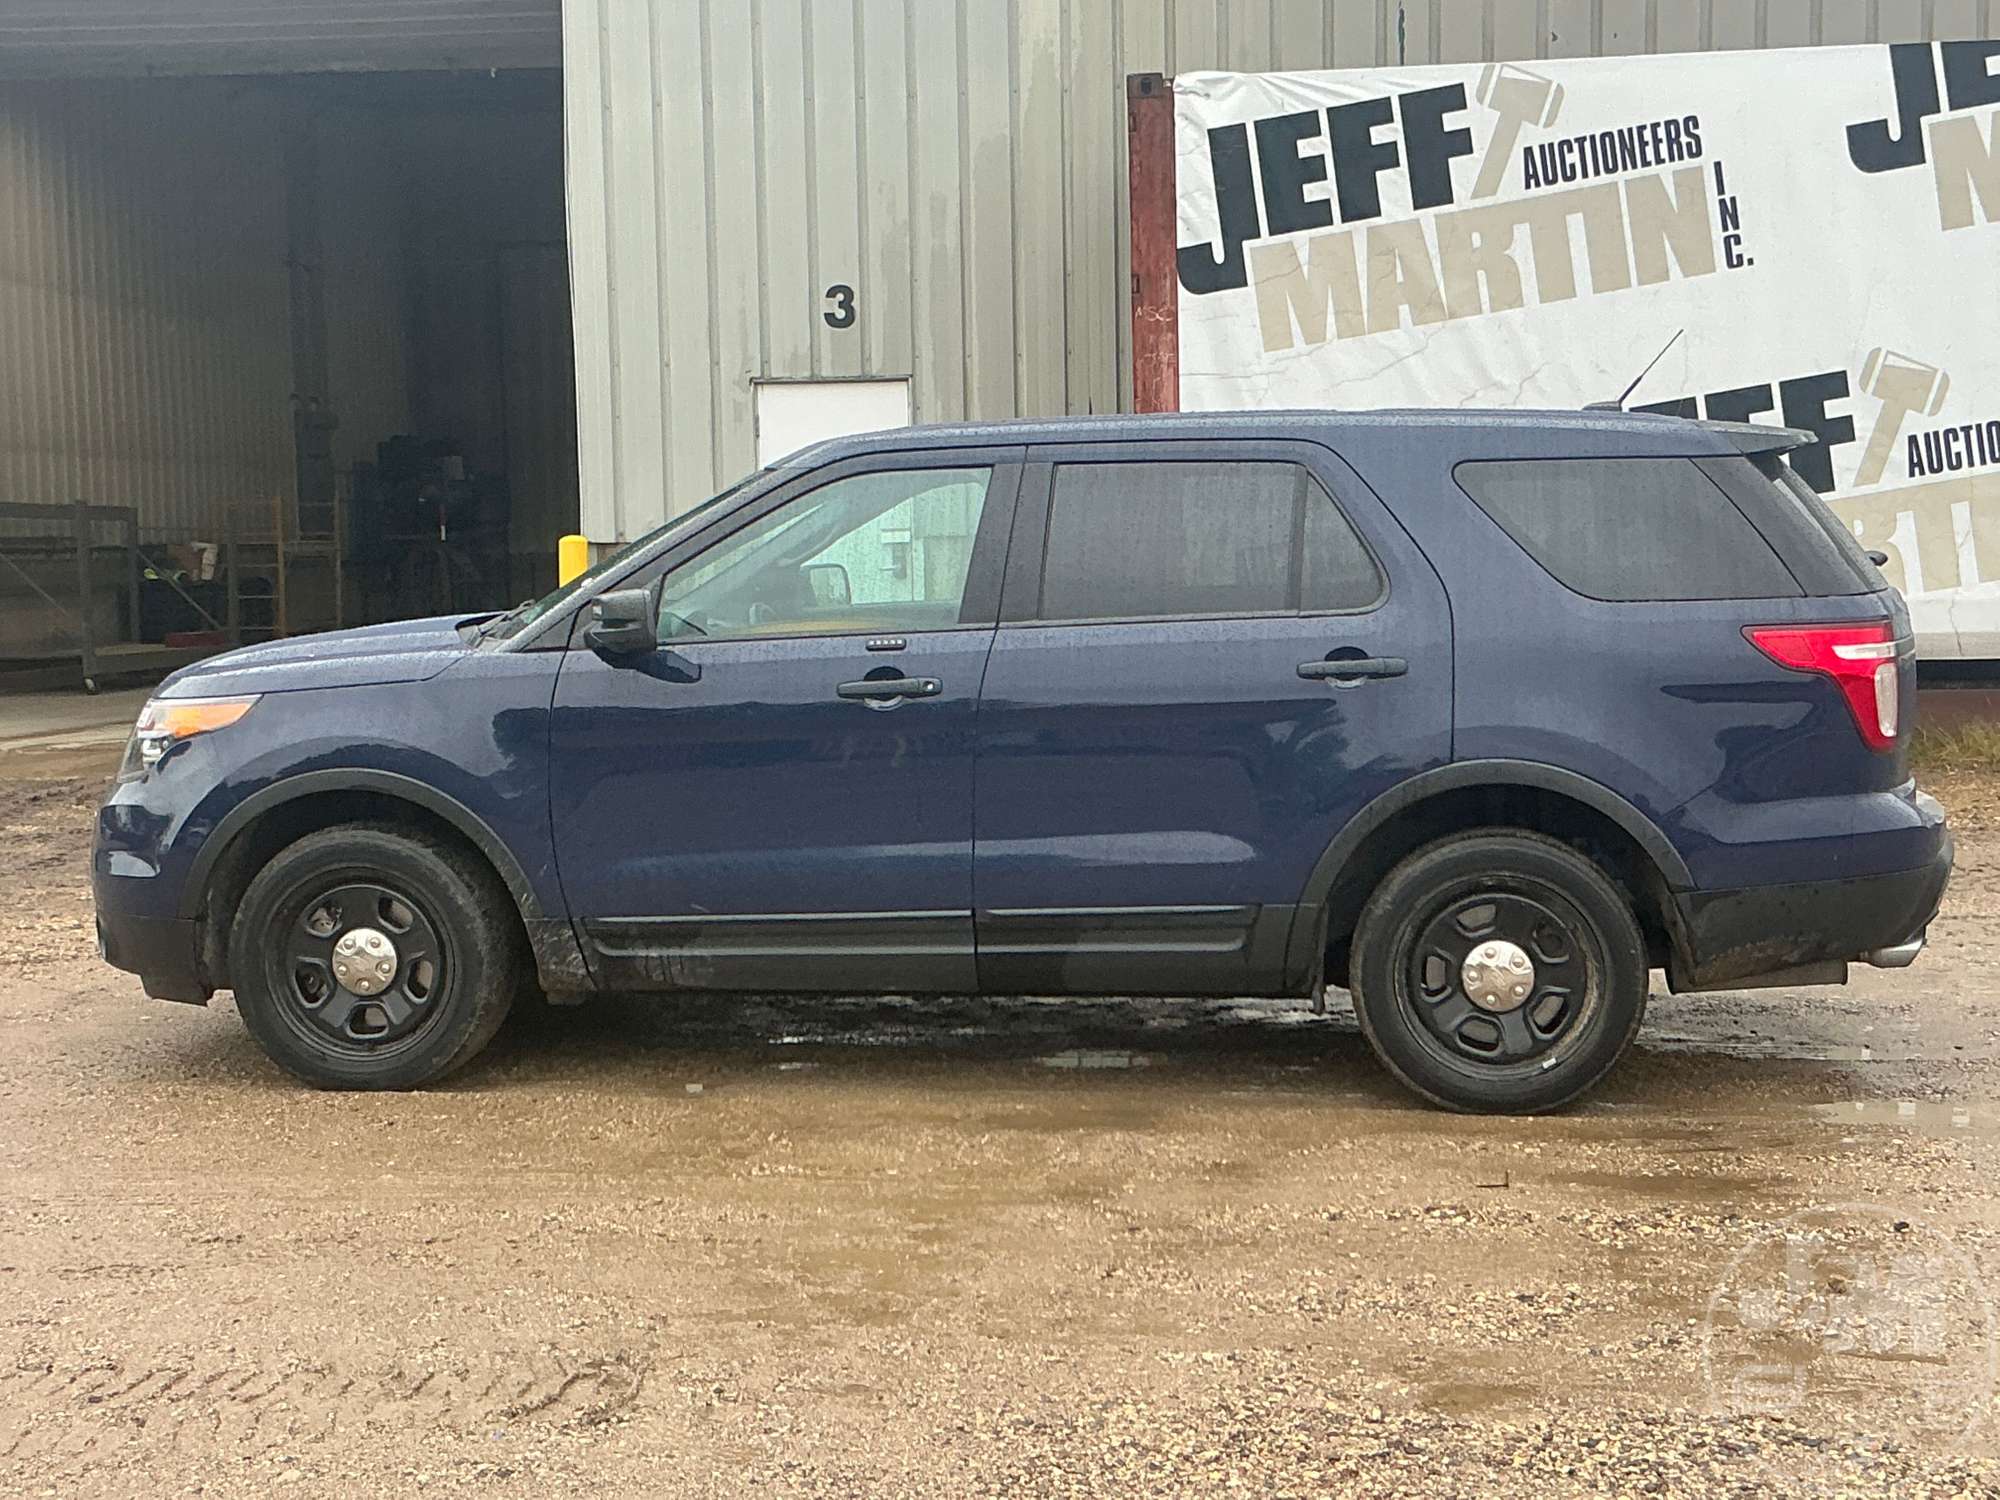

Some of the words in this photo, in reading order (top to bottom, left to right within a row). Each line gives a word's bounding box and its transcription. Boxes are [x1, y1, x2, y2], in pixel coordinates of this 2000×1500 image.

[1176, 83, 1474, 295] JEFF
[1523, 115, 1703, 190] AUCTIONEERS
[1250, 165, 1716, 352] MARTIN
[1713, 160, 1754, 269] INC.
[824, 284, 856, 328] 3
